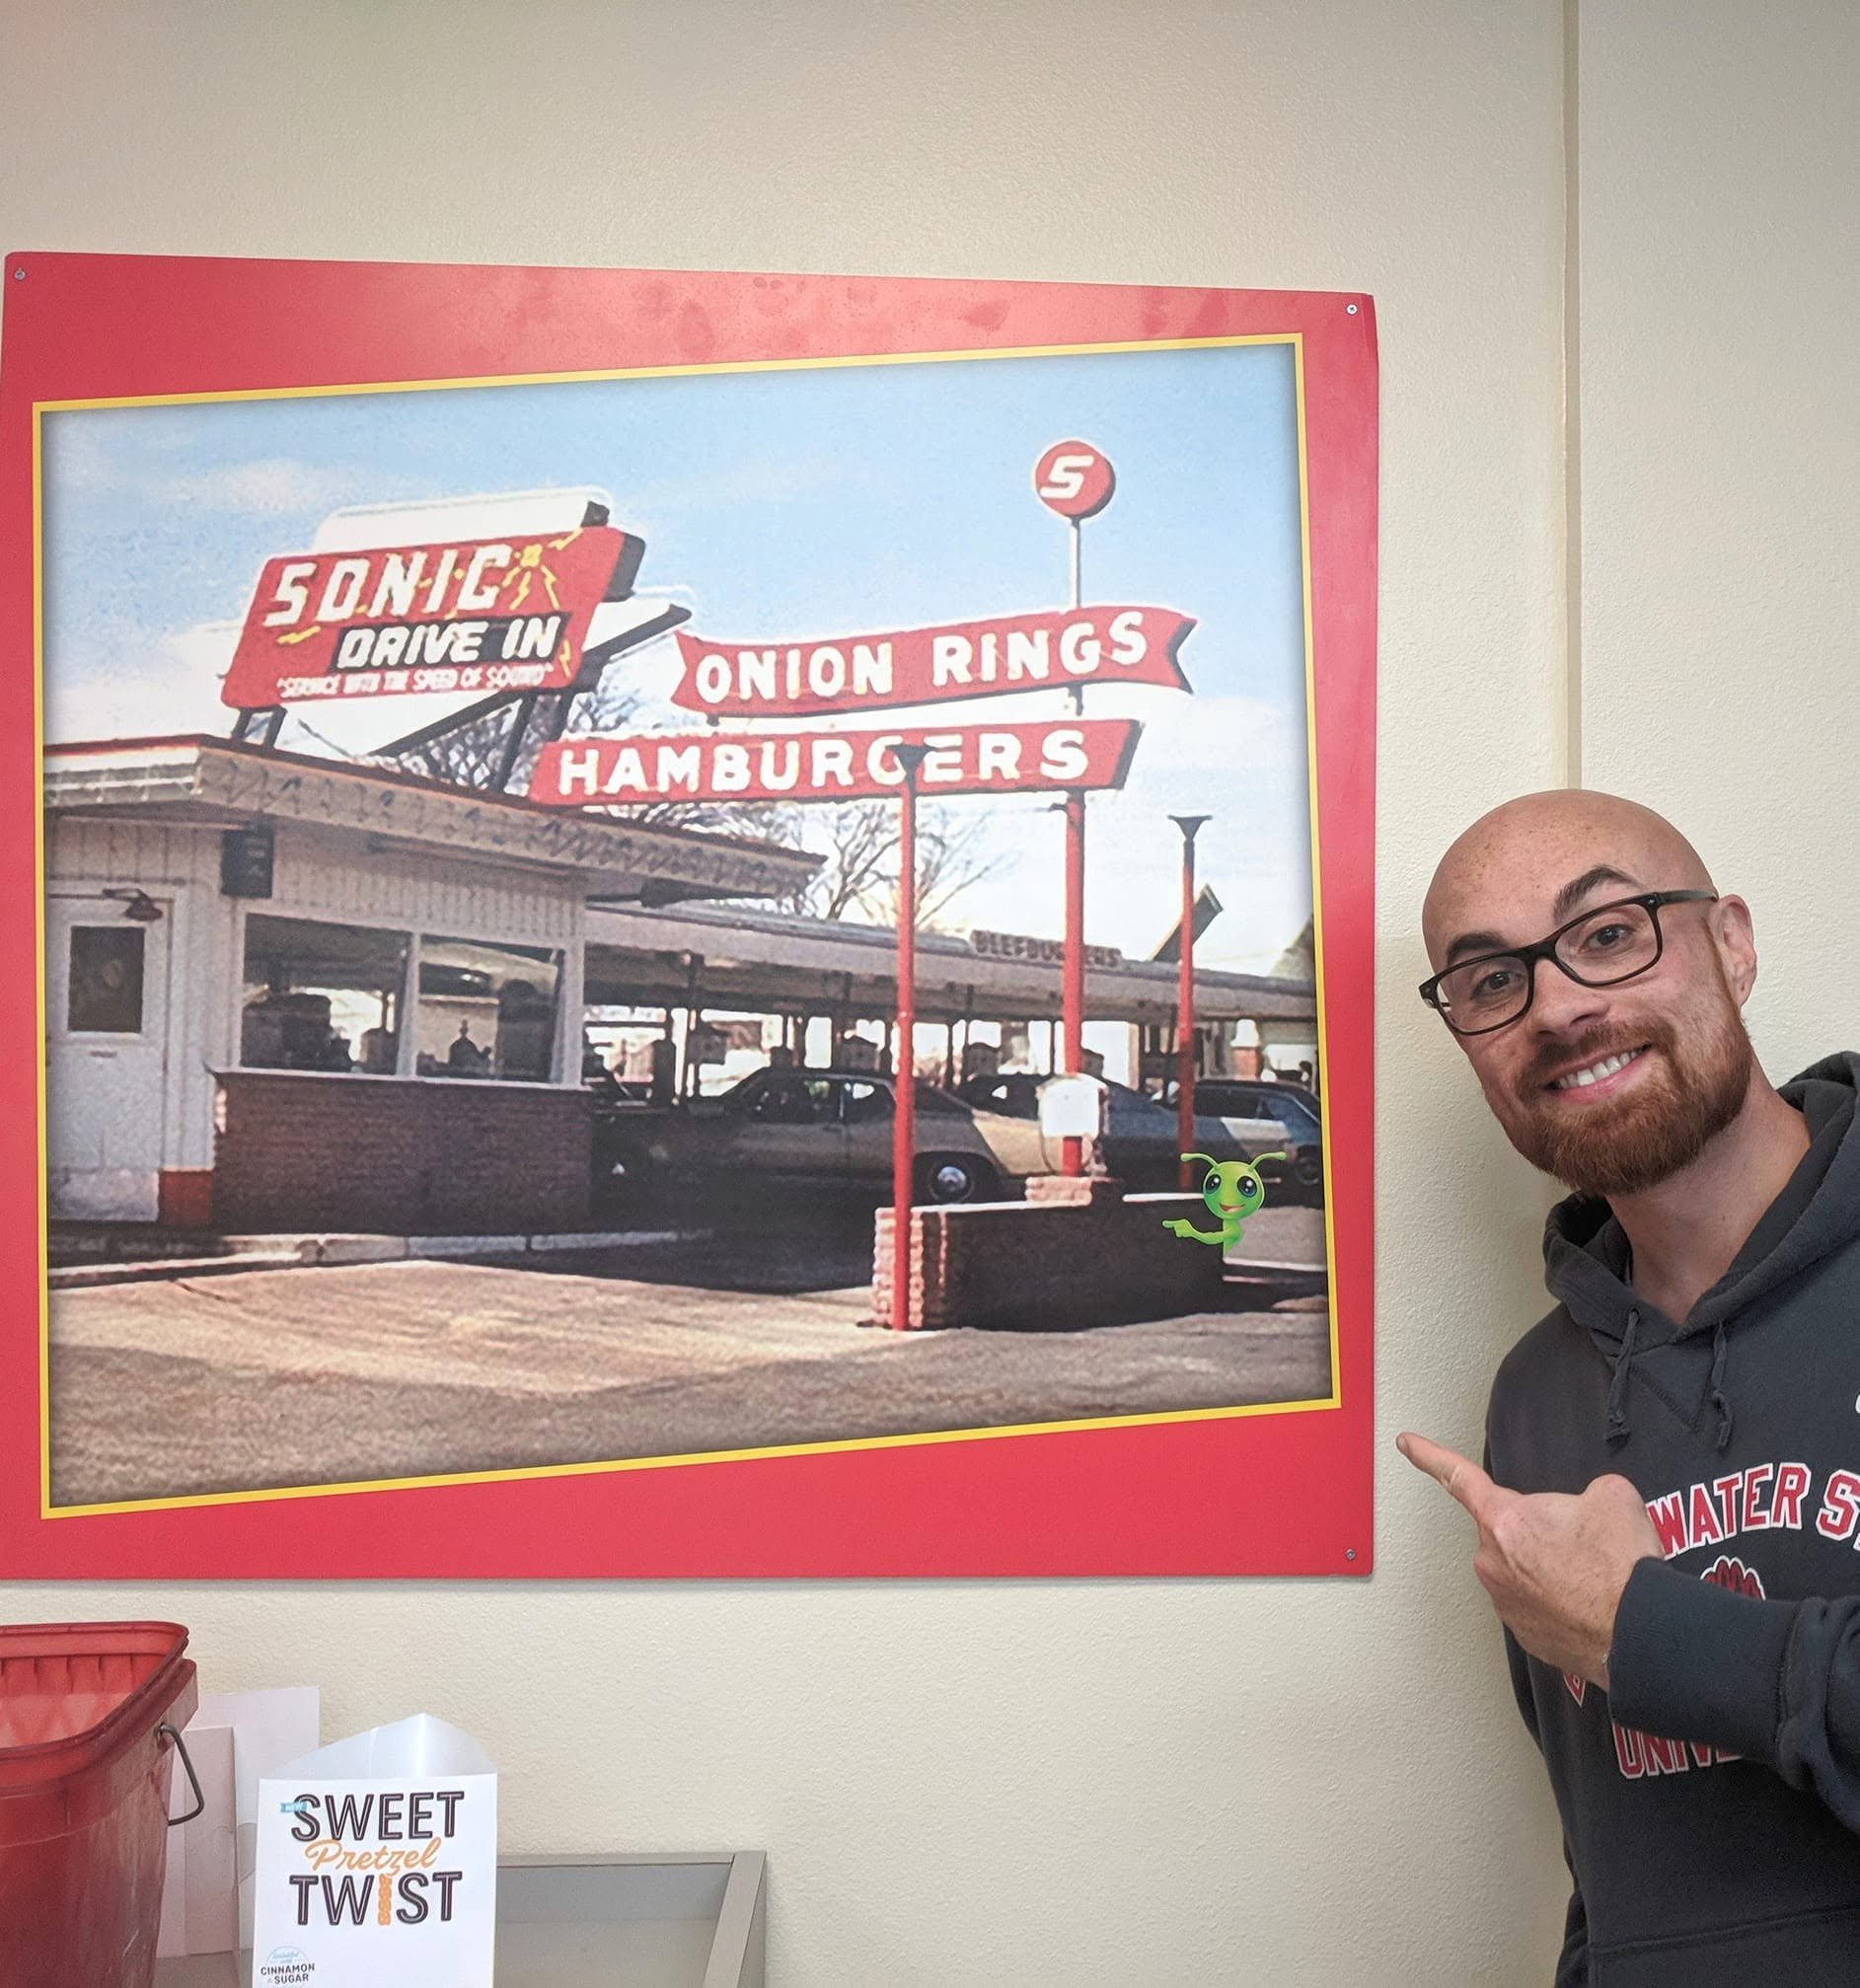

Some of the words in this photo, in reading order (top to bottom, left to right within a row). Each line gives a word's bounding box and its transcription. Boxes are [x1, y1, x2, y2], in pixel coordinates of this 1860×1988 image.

[1040, 455, 1094, 499] S
[262, 544, 512, 627] SONIC
[336, 622, 488, 669] DRIVE
[501, 616, 560, 659] IN
[696, 641, 892, 704] ONION
[931, 611, 1148, 687] RINGS
[460, 667, 483, 688] OF
[558, 730, 1087, 794] HAMBURGERS
[291, 1791, 465, 1842] SWEET
[304, 1836, 442, 1873] Pretzel
[289, 1871, 463, 1926] TWIST
[260, 1963, 315, 1975] CINNAMON
[274, 1973, 309, 1984] SUGAR
